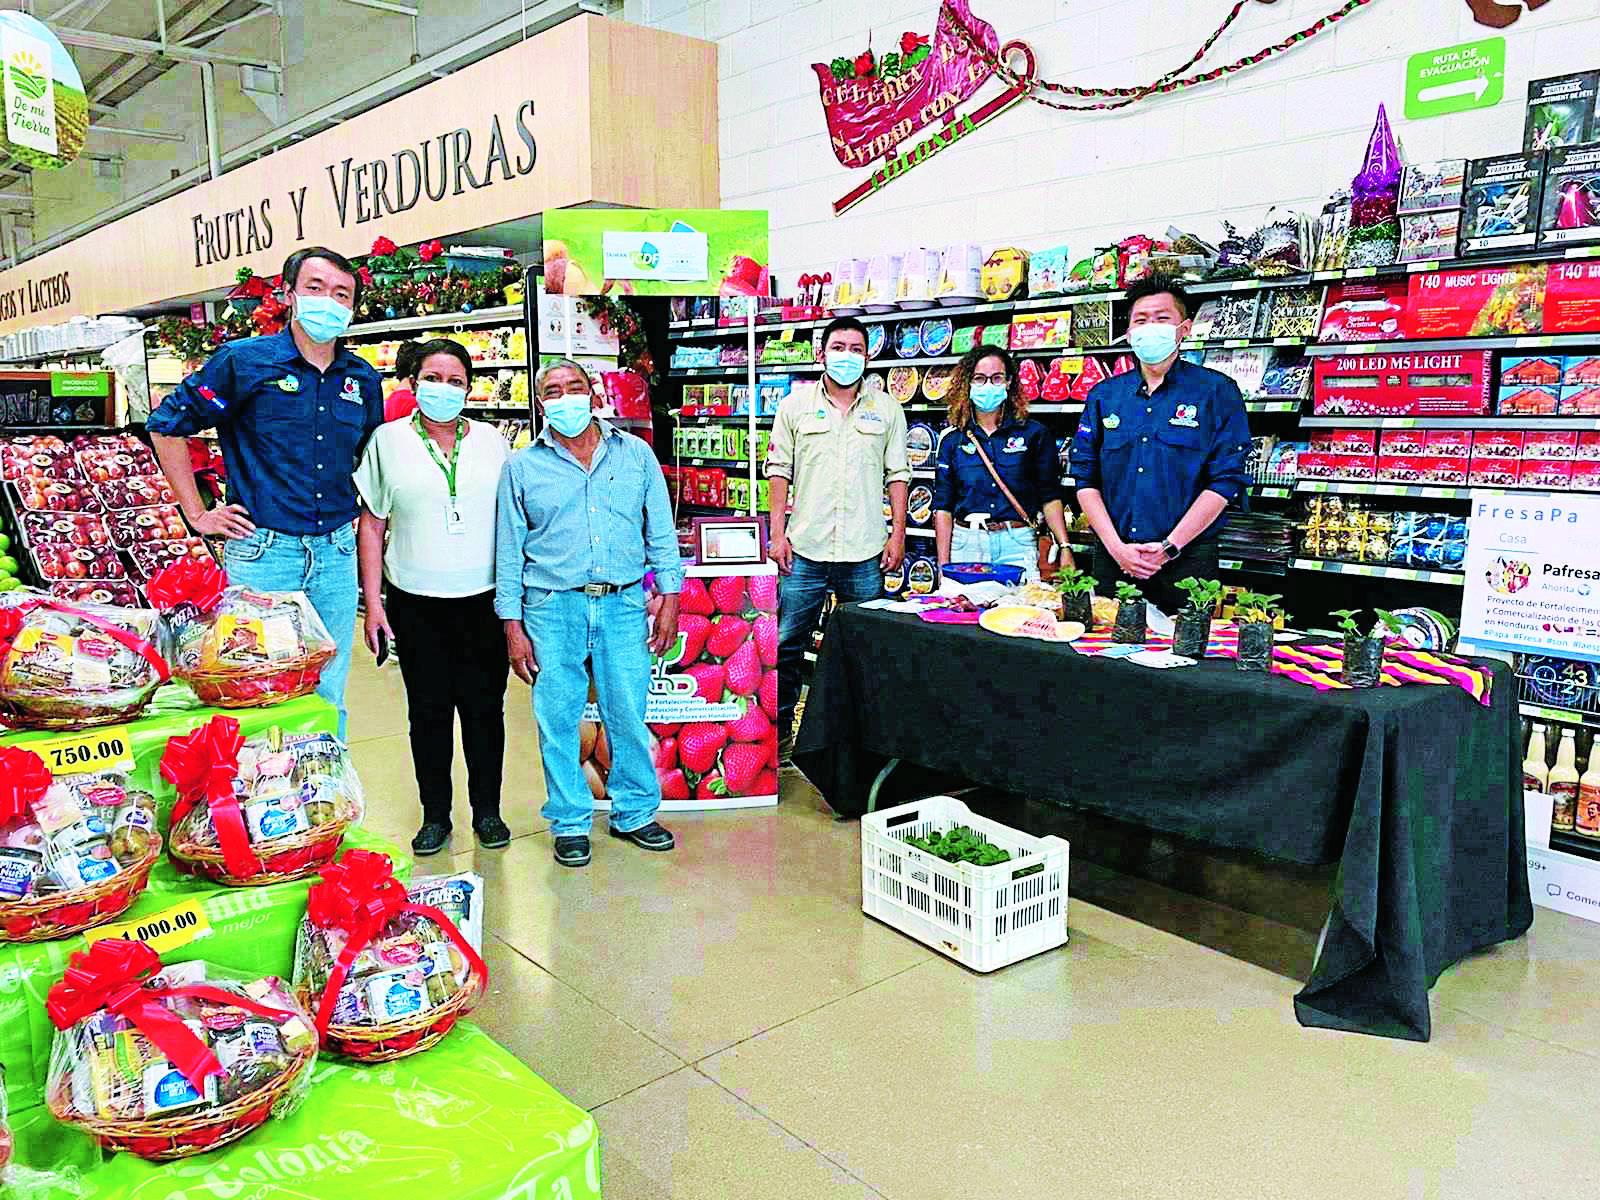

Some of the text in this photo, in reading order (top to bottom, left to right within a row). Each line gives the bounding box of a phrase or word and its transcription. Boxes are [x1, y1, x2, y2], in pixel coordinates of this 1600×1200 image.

[1419, 55, 1490, 78] EVACUACIÓN
[1432, 48, 1477, 65] RUTA DE
[822, 66, 923, 106] CELEBRA
[15, 96, 45, 117] De mi
[920, 88, 963, 125] CON
[12, 112, 50, 136] Tierra
[832, 118, 913, 165] NAVIDAD
[871, 113, 976, 190] COLONIA
[191, 100, 538, 268] FRUTAS Y VERDURAS
[1419, 271, 1517, 289] 140 MUSIC LIGHTS
[1559, 264, 1583, 280] 140
[18, 287, 25, 316] Y
[28, 271, 71, 313] LACTEOS
[1345, 321, 1377, 329] Christmas
[1336, 354, 1464, 371] 200 LED M5 LIGHT
[1499, 532, 1527, 545] Casa
[1542, 583, 1574, 593] Ahorita
[1487, 595, 1524, 606] Proyecto
[1582, 617, 1594, 627] las
[50, 739, 124, 766] 750.00
[1528, 860, 1547, 871] 99+
[223, 911, 273, 935] mejor
[204, 1129, 376, 1198] Colonia
